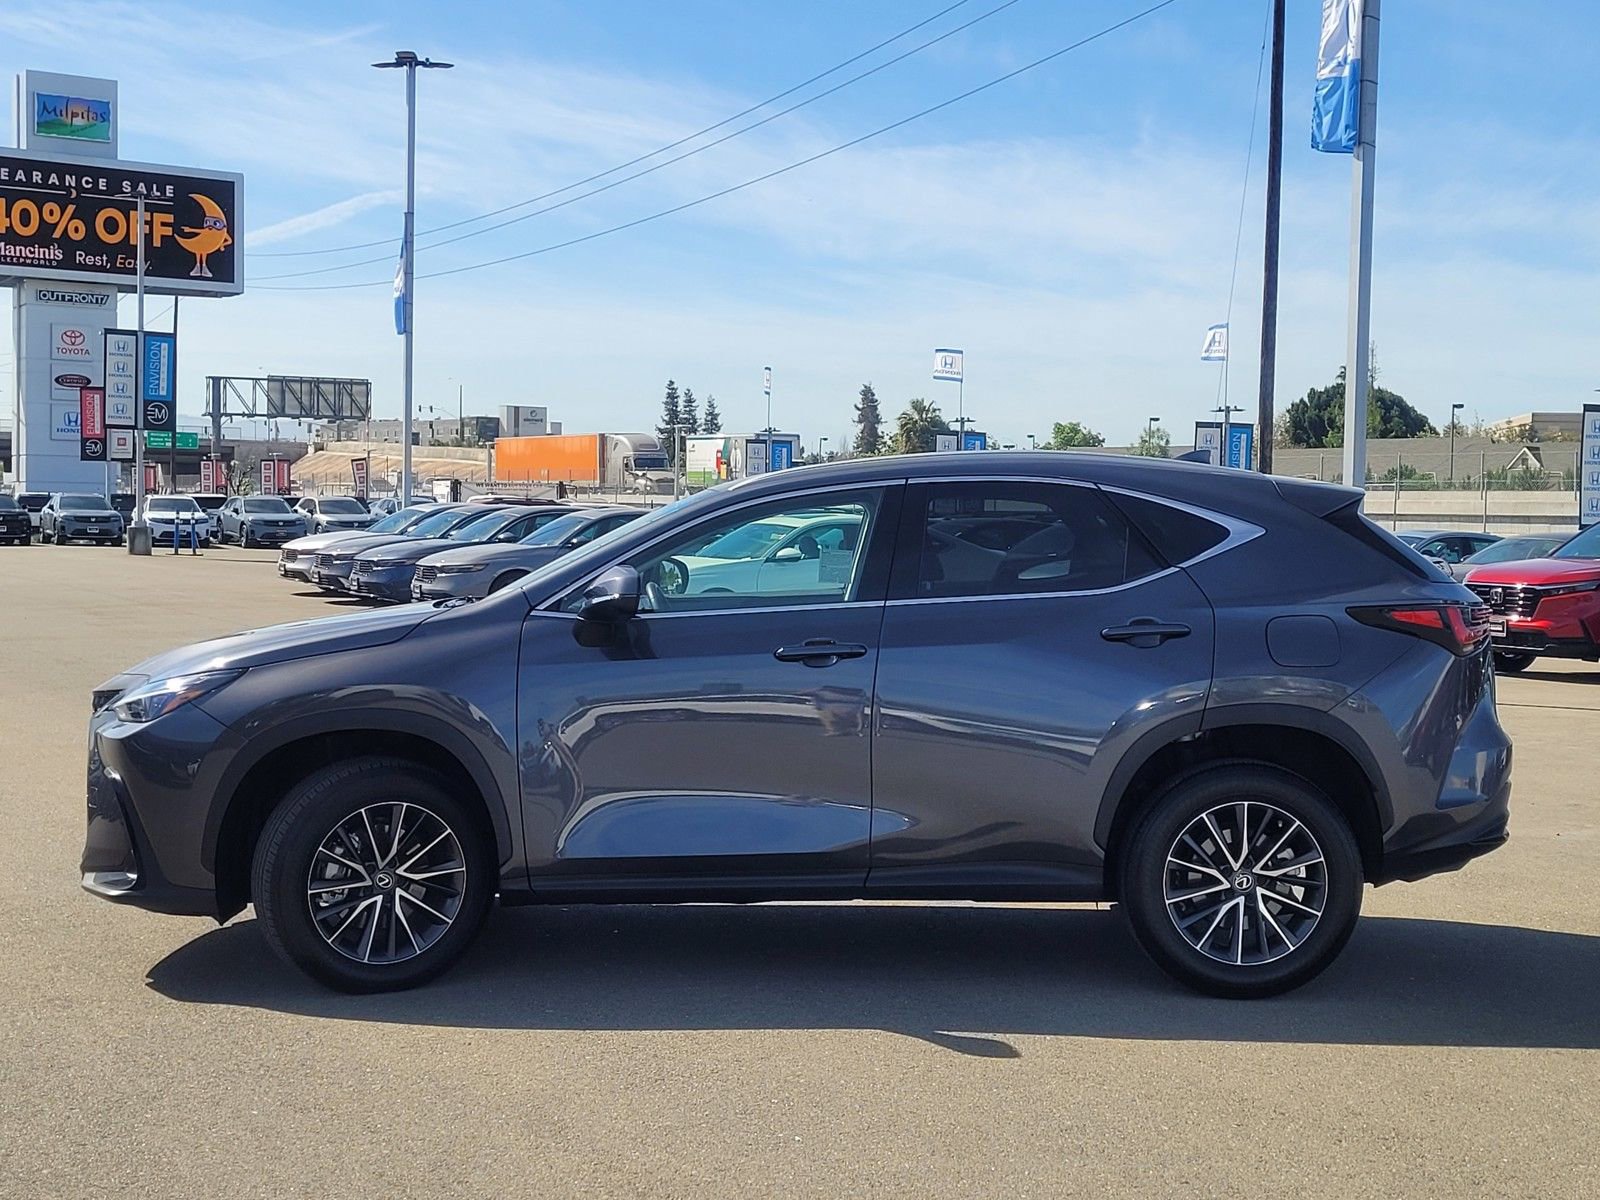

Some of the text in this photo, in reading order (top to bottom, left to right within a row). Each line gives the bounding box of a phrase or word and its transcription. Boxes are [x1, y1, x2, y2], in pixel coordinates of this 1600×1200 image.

[41, 98, 106, 128] Milpitas
[122, 180, 174, 197] SALE
[95, 207, 174, 247] OFF
[76, 251, 152, 272] Rest, Eay.
[56, 347, 90, 355] TOYOTA
[149, 341, 160, 395] ENVISION
